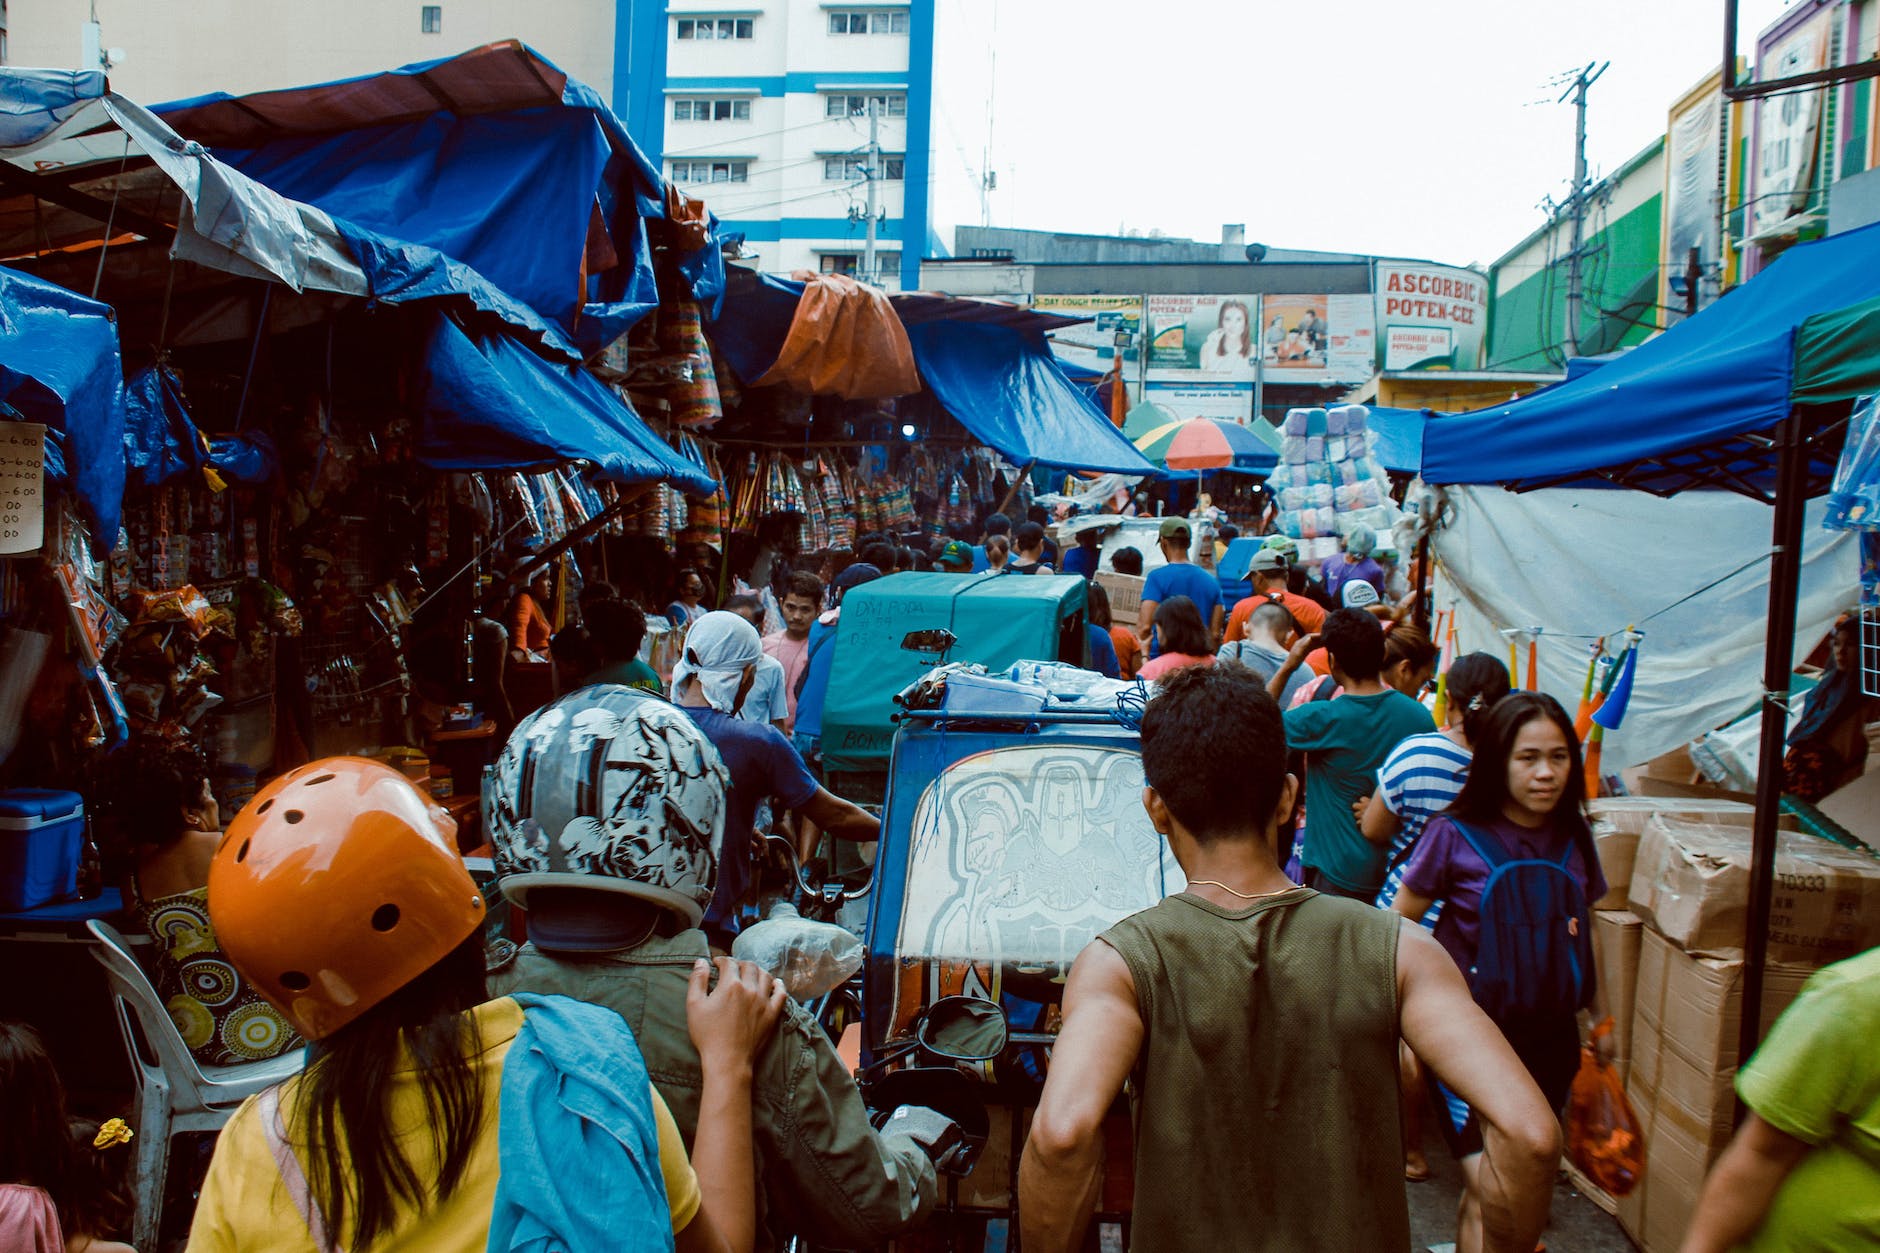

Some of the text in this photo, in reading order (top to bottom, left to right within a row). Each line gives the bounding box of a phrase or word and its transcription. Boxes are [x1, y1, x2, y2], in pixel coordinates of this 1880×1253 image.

[1387, 273, 1475, 302] ASCORBIC
[1062, 298, 1088, 306] COUGH
[1386, 298, 1473, 324] POTEN-CEE
